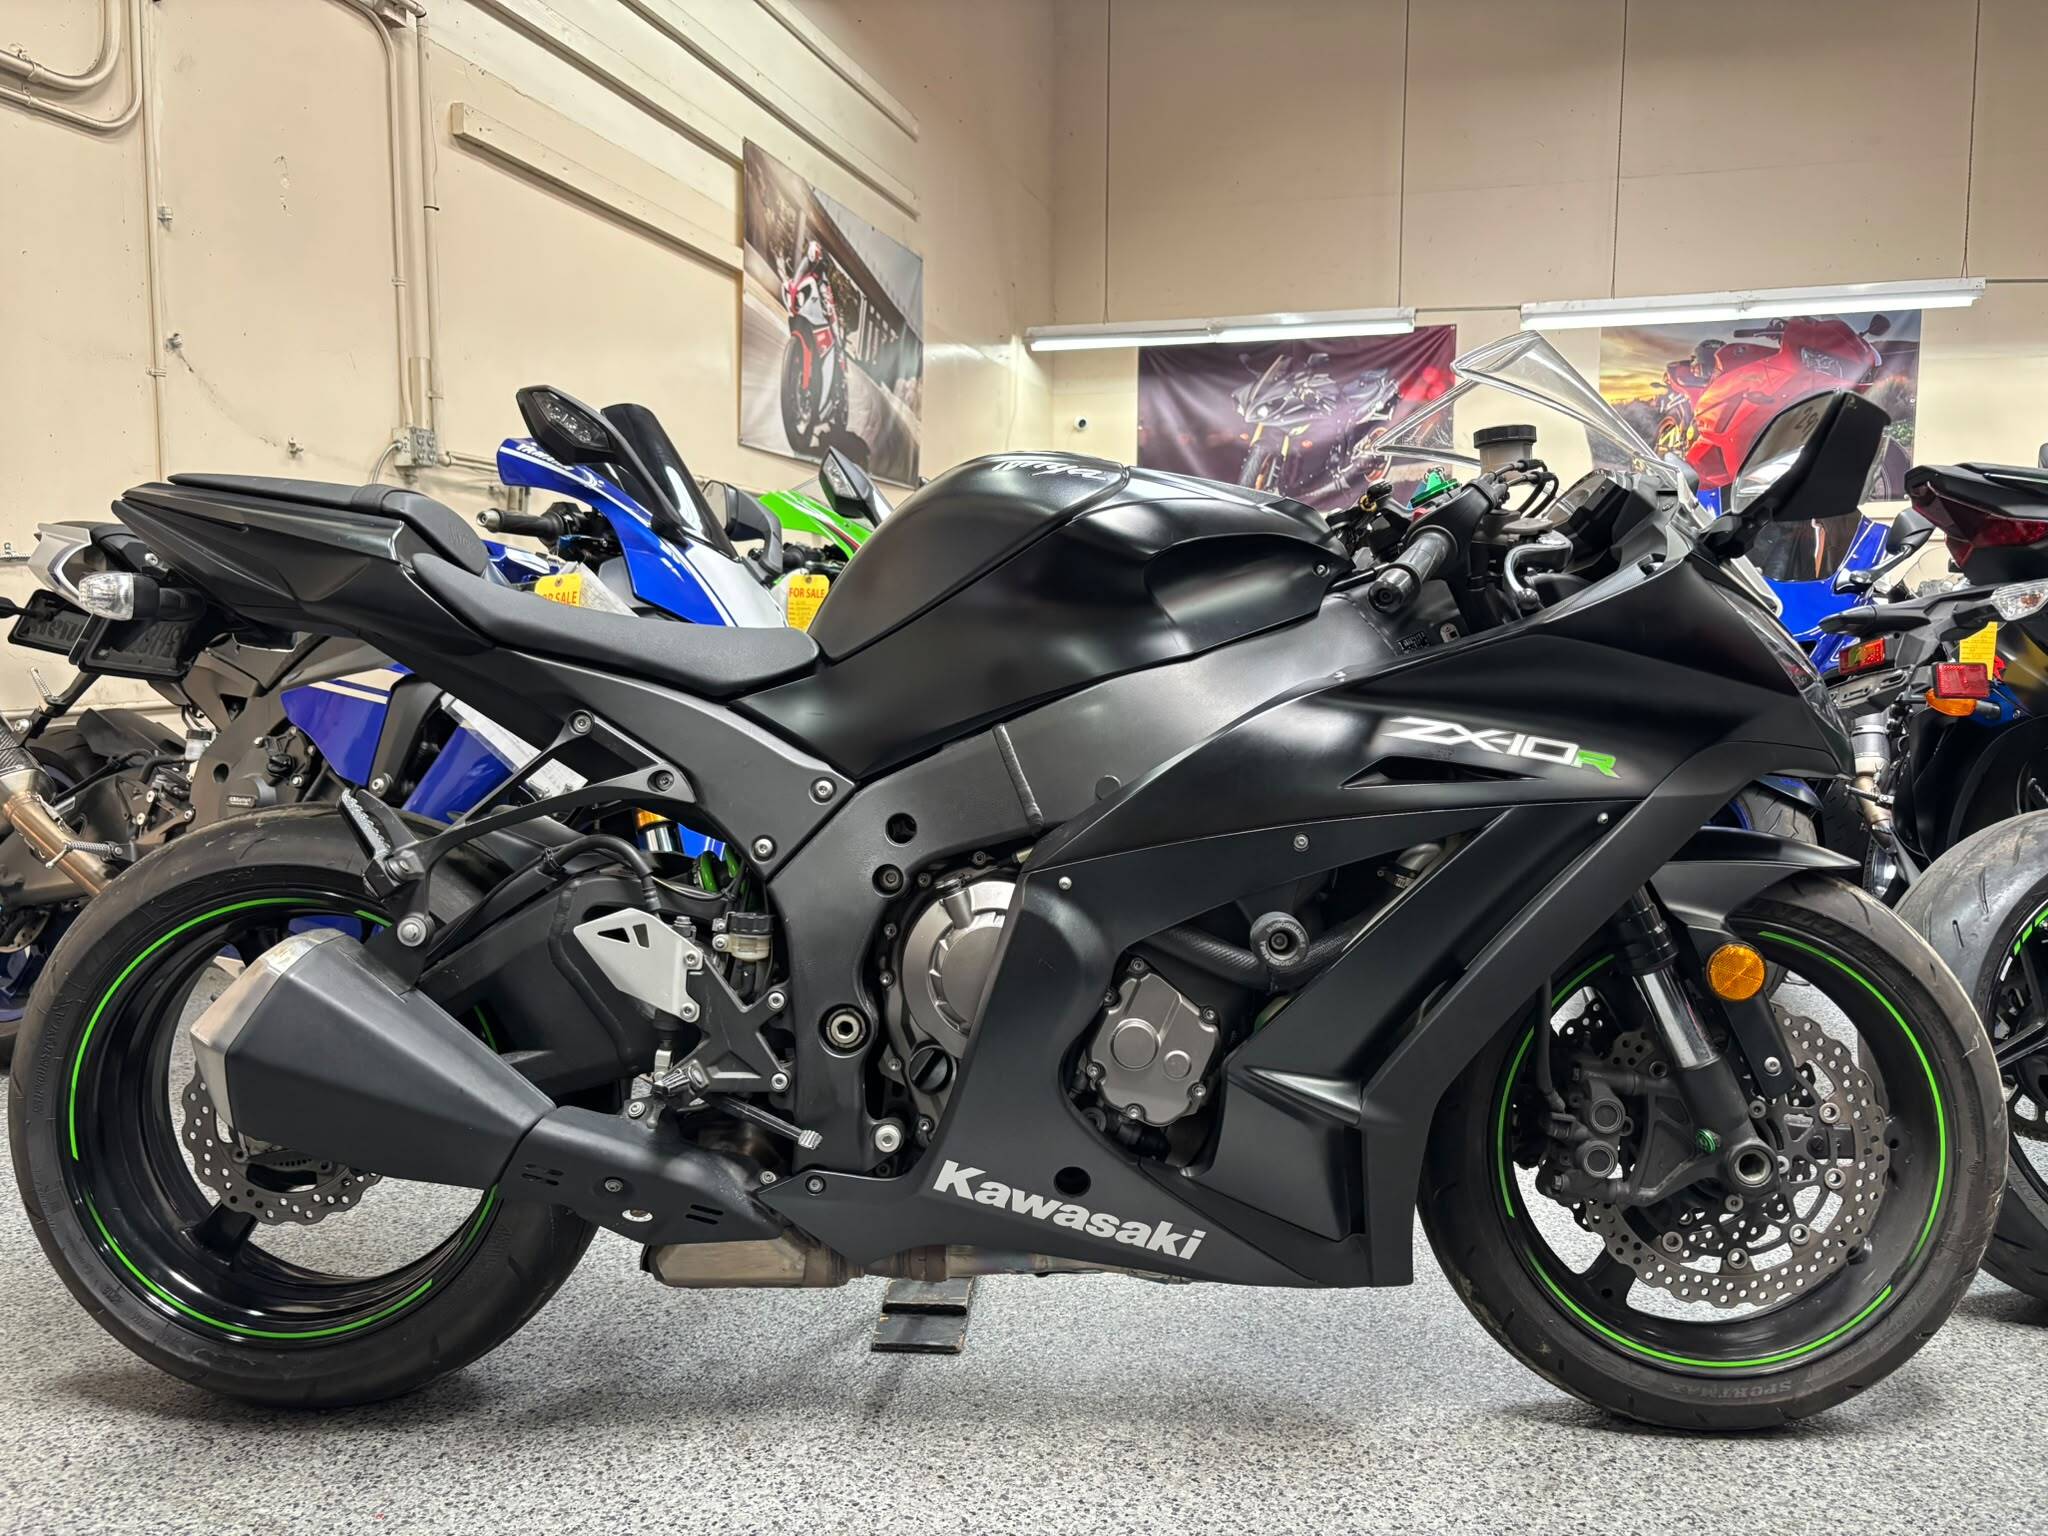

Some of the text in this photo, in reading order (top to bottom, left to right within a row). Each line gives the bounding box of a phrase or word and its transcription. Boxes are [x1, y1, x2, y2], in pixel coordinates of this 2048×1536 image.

[555, 591, 578, 604] SALE
[789, 587, 825, 599] FOR SALE
[1381, 716, 1622, 780] ZX-10R
[933, 1159, 1207, 1260] Kawasaki
